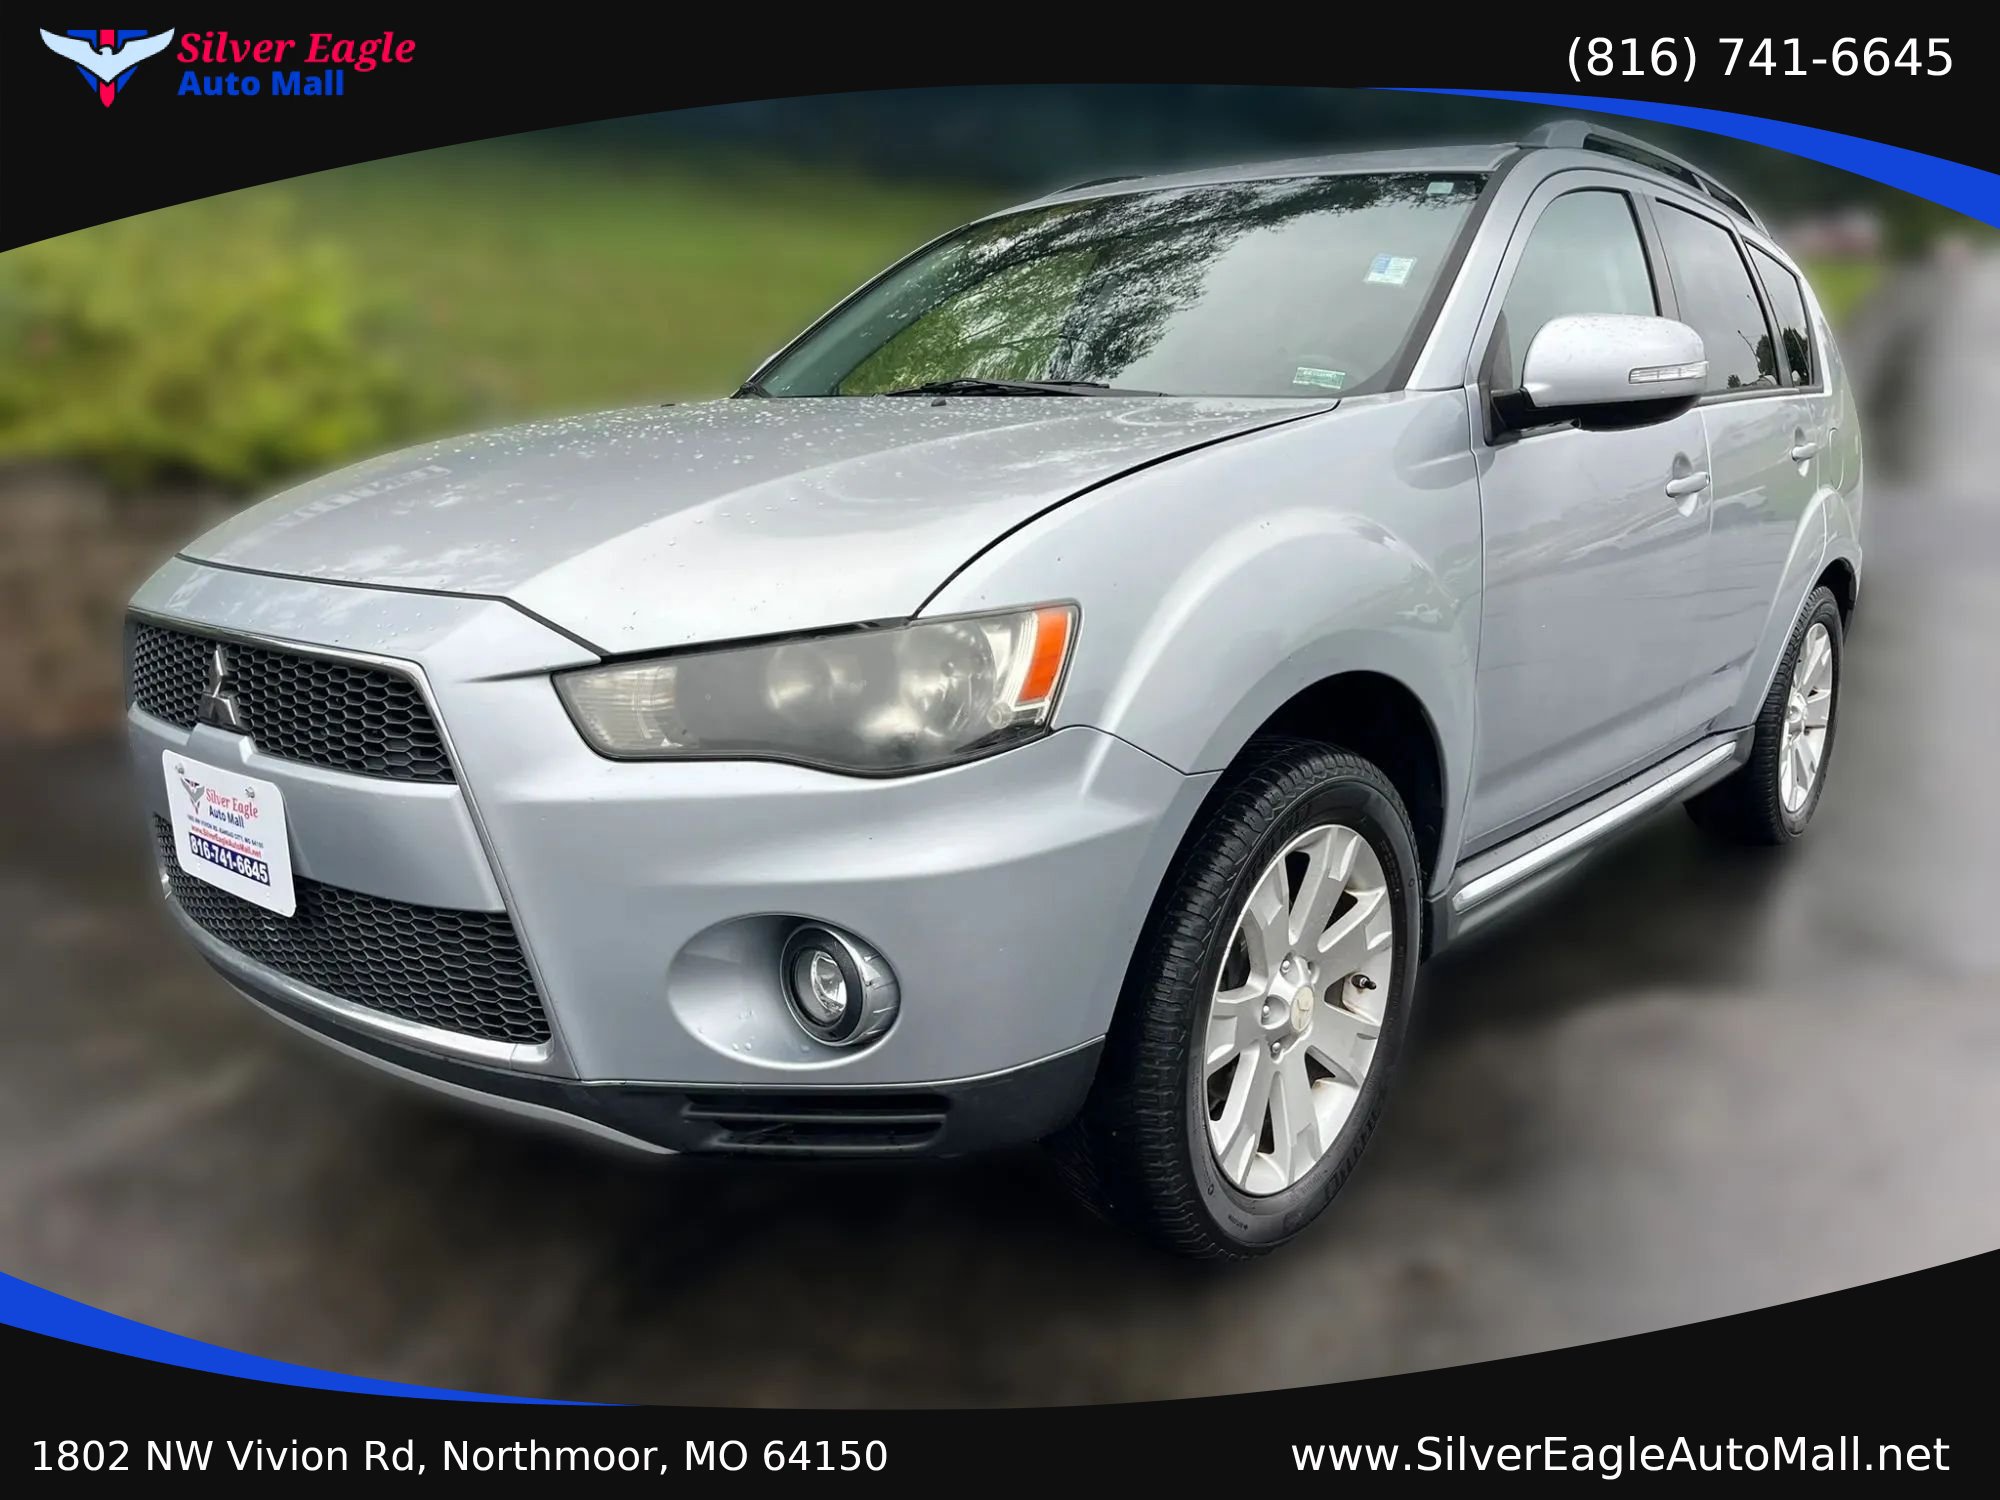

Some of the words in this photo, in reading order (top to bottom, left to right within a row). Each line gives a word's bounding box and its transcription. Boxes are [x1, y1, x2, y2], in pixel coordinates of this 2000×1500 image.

[206, 788, 231, 808] Silver
[232, 797, 258, 819] Eagle
[209, 805, 226, 821] Auto
[227, 812, 245, 829] Mall
[190, 835, 268, 883] 816-741-6645
